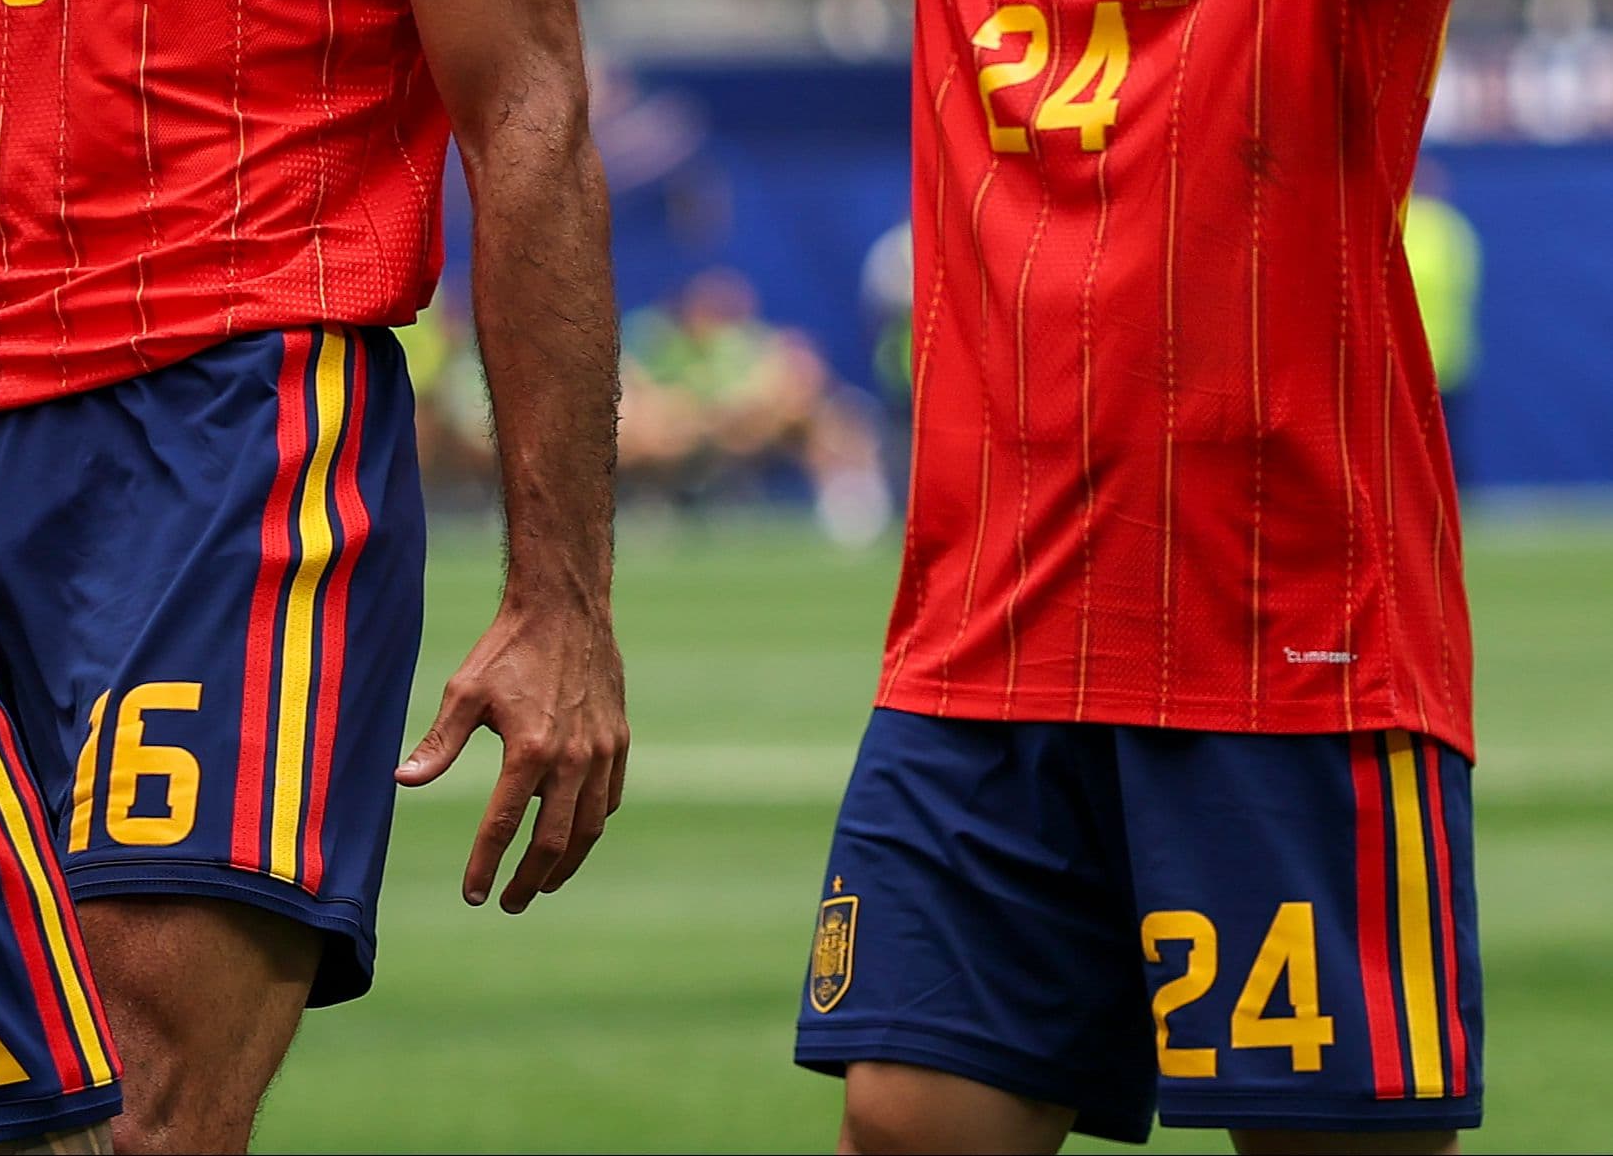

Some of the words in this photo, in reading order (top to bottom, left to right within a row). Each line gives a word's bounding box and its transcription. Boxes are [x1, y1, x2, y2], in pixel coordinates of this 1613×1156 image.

[972, 1, 1131, 154] 24
[67, 682, 203, 853] 16
[1140, 901, 1334, 1078] 24
